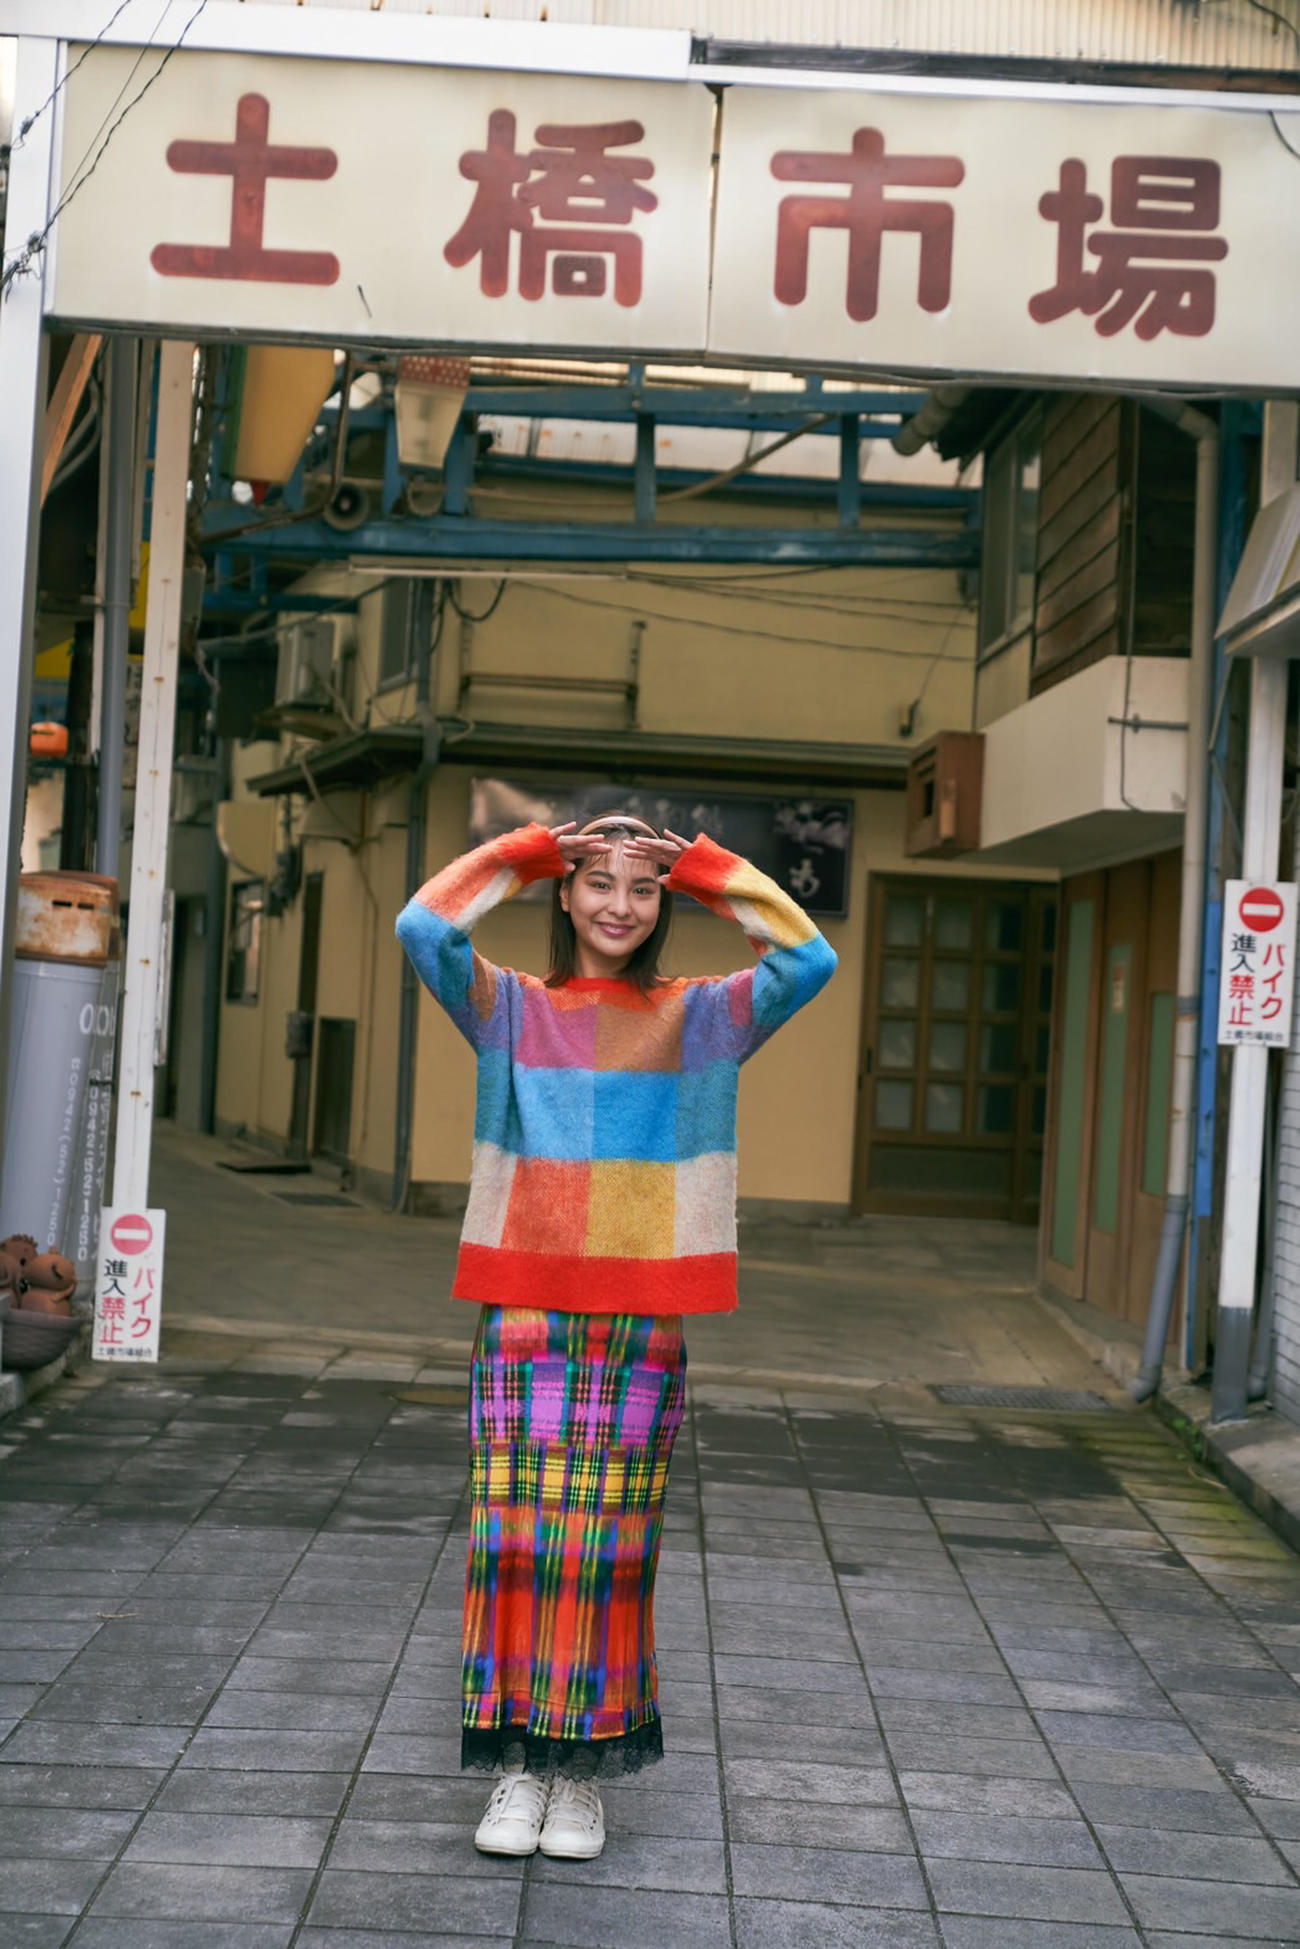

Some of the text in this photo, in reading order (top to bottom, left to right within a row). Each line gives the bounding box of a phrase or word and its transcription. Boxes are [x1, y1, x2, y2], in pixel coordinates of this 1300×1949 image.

[150, 92, 1229, 341] 土橋市場
[1227, 933, 1257, 1026] 進入禁止
[1261, 943, 1286, 1020] バイク
[100, 1258, 128, 1344] 進入禁止
[131, 1268, 156, 1339] バイク
